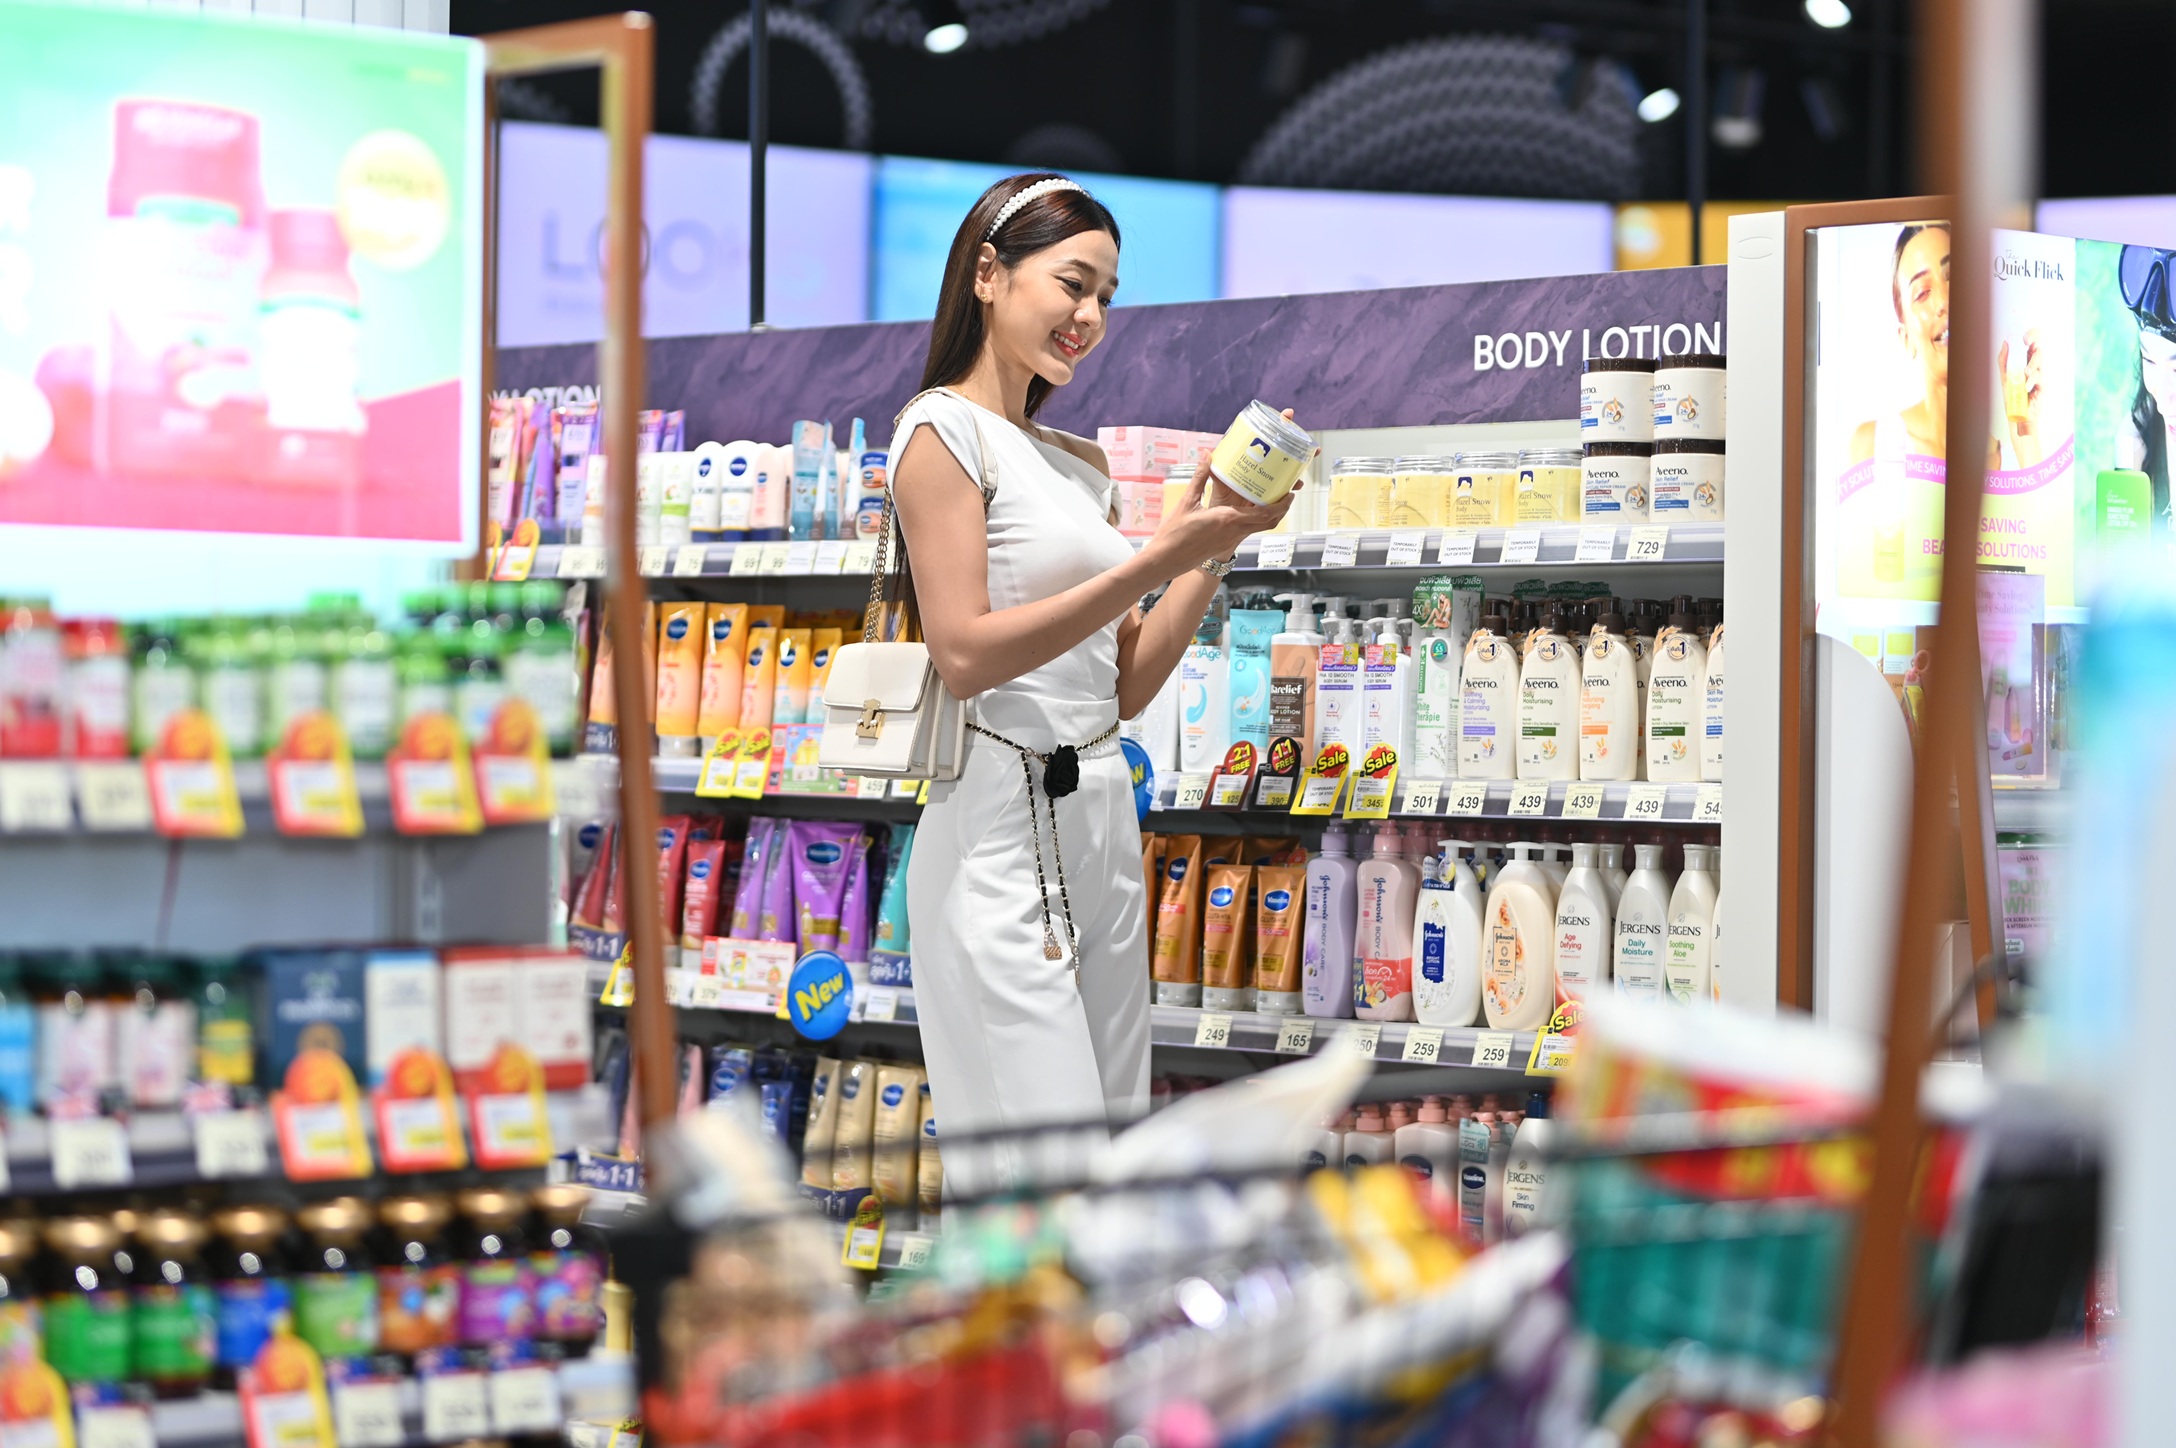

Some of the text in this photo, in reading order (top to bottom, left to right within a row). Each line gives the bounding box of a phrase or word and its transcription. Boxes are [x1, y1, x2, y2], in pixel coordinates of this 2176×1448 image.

[1993, 255, 2065, 281] Quick Flick
[1474, 321, 1721, 371] BODY LOTION
[1236, 460, 1250, 474] Body
[1240, 454, 1258, 471] Hazel
[1257, 467, 1275, 482] Snow
[1655, 466, 1689, 476] Aveeno.
[1905, 460, 1946, 477] TIME SAVIN
[2038, 460, 2059, 481] TIME
[1586, 469, 1620, 479] Aveeno.
[1980, 517, 2026, 534] SAVING
[1637, 541, 1659, 554] 729
[1922, 539, 1945, 554] BEA
[1976, 541, 2047, 560] SOLUTIONS
[1996, 589, 2024, 601] Saving
[1412, 604, 1423, 615] 4X
[1489, 643, 1496, 656] 1
[1550, 642, 1556, 656] 1
[1576, 644, 1583, 658] 1
[1603, 640, 1609, 653] 1
[1636, 642, 1642, 656] 1
[1680, 642, 1686, 655] 1
[1464, 677, 1499, 690] Aveeno.
[1523, 677, 1559, 689] Aveeno.
[1652, 676, 1688, 689] Aveeno.
[1522, 691, 1535, 699] Daily
[1233, 743, 1252, 761] 2 1
[1274, 738, 1293, 759] 1 1
[1230, 760, 1251, 774] FREE
[1274, 756, 1295, 771] FREE
[1318, 750, 1347, 771] Sale
[1365, 752, 1396, 773] Sale
[1184, 789, 1203, 802] 270
[1227, 795, 1240, 804] 125
[1412, 795, 1433, 808] 501
[1519, 795, 1541, 808] 439
[1571, 795, 1595, 809] 439
[1367, 799, 1381, 808] 345
[1457, 796, 1479, 809] 439
[1635, 800, 1658, 813] 439
[2009, 878, 2051, 896] BODY
[1319, 874, 1331, 921] Johnson's
[1373, 877, 1386, 923] Johnson's
[1557, 913, 1591, 927] JERGENS
[1618, 920, 1661, 936] JERGENS
[1667, 922, 1702, 937] JERGENS
[1424, 930, 1444, 940] Johnson's
[1495, 932, 1515, 942] Johnson's
[1564, 933, 1576, 942] Age
[1559, 940, 1582, 951] Defying
[1628, 938, 1646, 949] Daily
[1668, 940, 1695, 951] Soothing
[1621, 947, 1654, 956] Moisture
[1673, 950, 1687, 958] Aloe
[794, 971, 845, 1022] New
[1554, 1010, 1585, 1031] Sale
[1205, 1028, 1225, 1041] 249
[1287, 1034, 1307, 1047] 165
[1413, 1042, 1435, 1056] 259
[1482, 1048, 1505, 1062] 259
[1553, 1057, 1568, 1067] 209
[1506, 1168, 1545, 1185] JERGENS
[1516, 1193, 1530, 1201] Skin
[1511, 1200, 1535, 1212] Firming
[908, 1251, 924, 1263] 169
[623, 1416, 643, 1429] Sale
